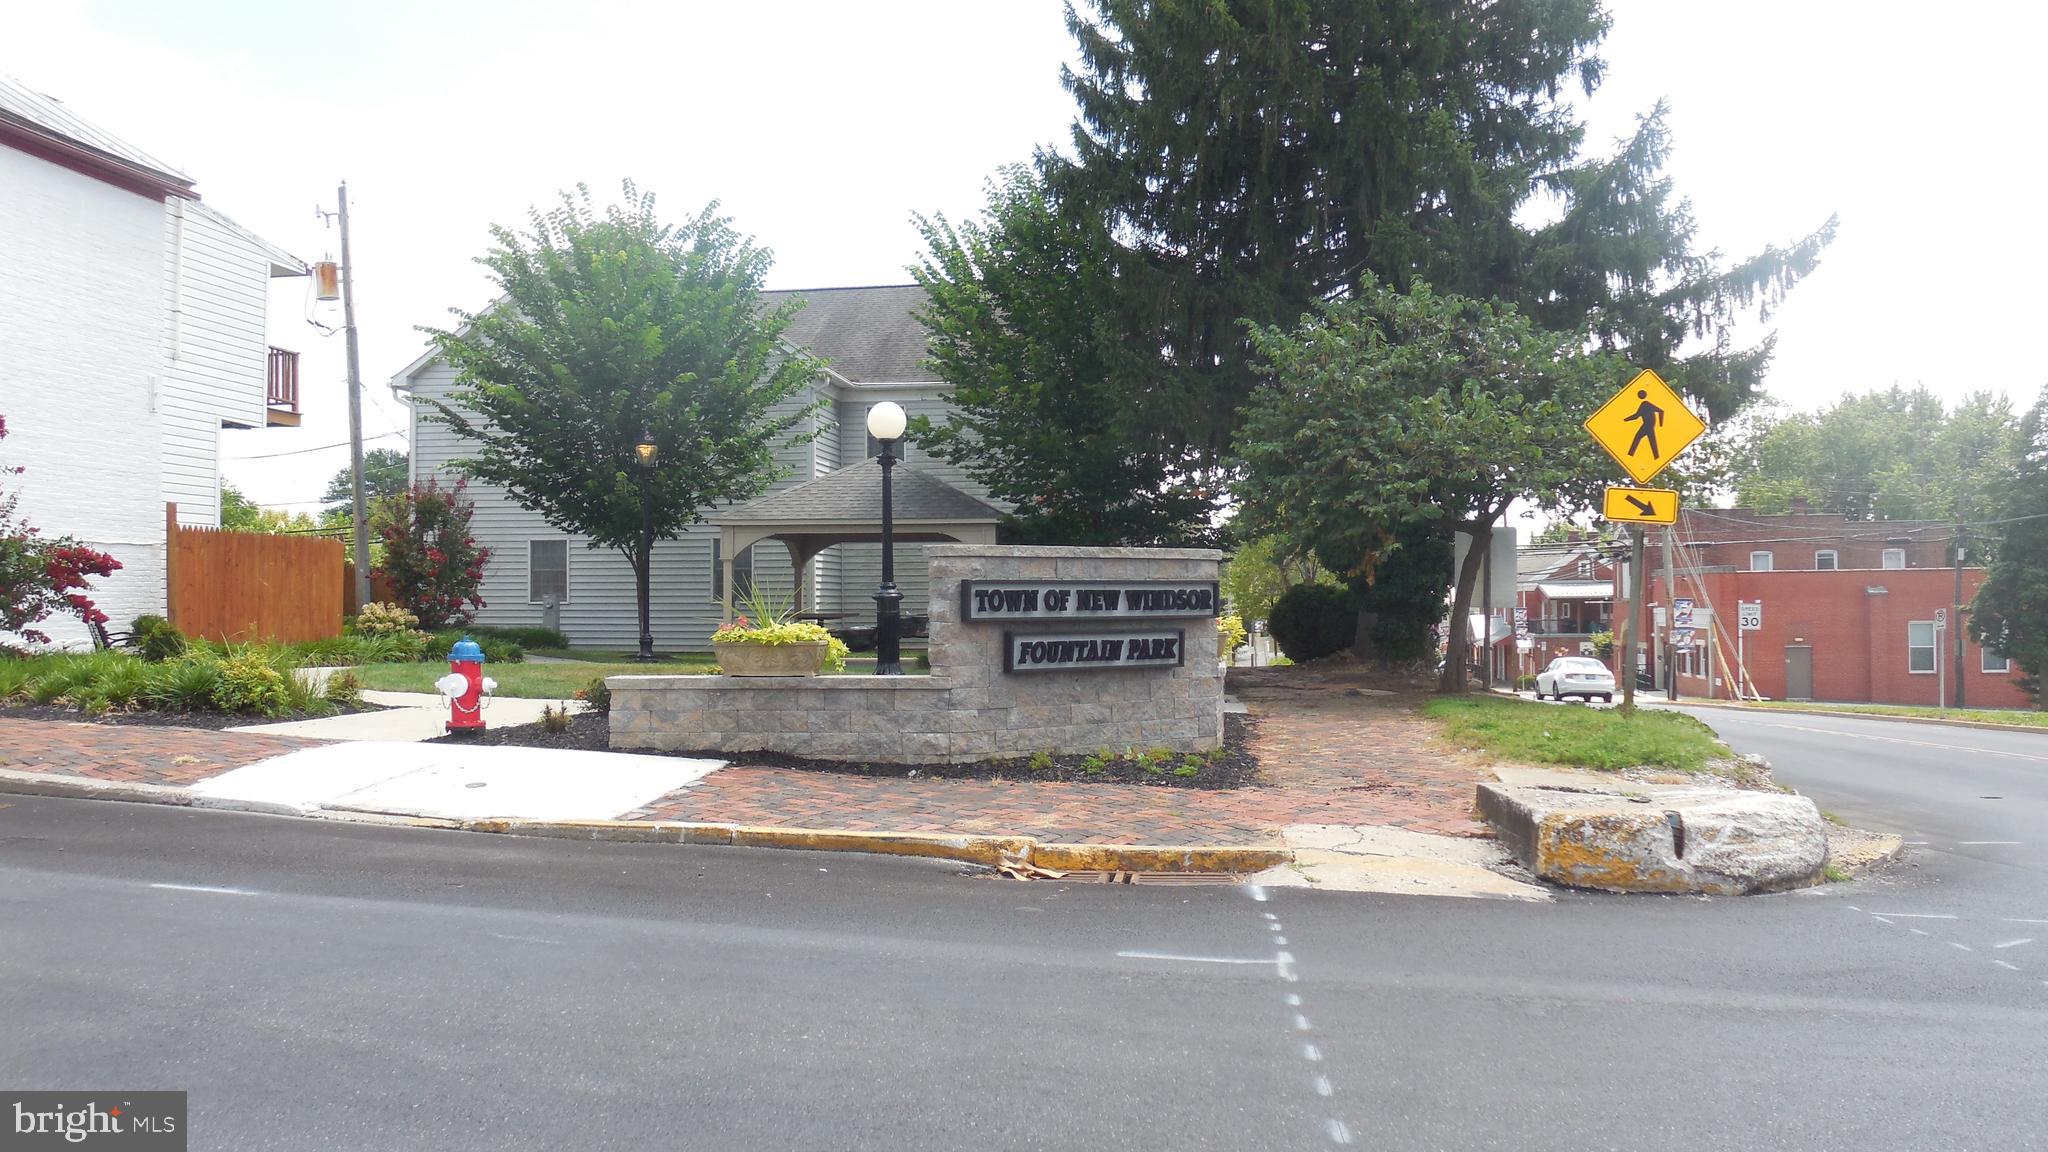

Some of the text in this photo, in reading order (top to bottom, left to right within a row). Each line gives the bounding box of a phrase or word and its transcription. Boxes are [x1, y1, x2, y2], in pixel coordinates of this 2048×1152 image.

[975, 589, 1213, 612] TOWN OF NEW WINDSOR
[1741, 617, 1759, 627] 30
[1018, 638, 1178, 664] FOUNTAIN PARK
